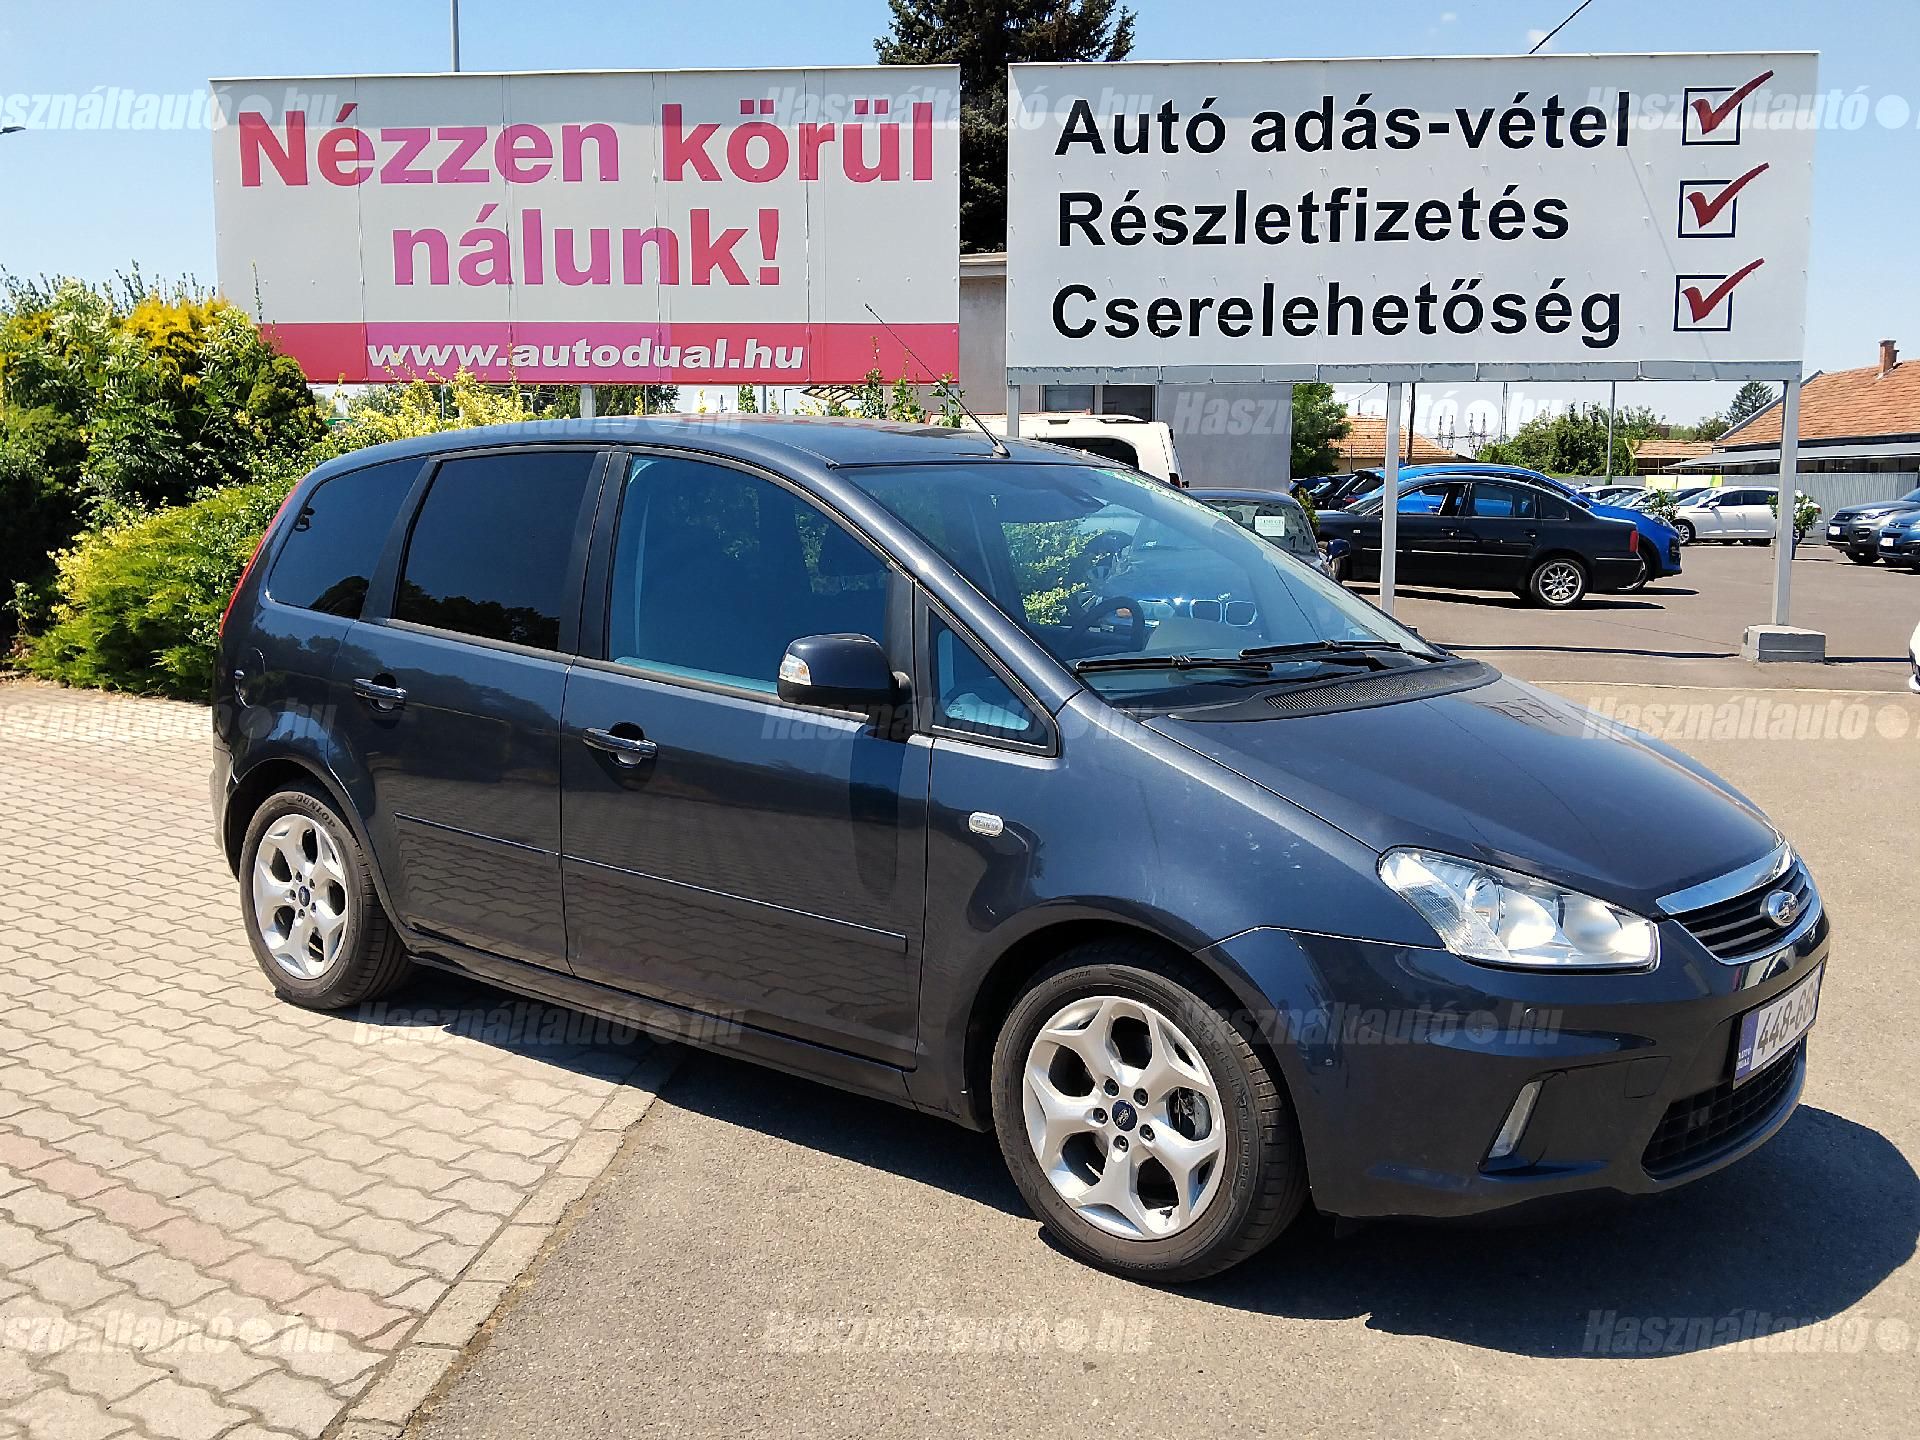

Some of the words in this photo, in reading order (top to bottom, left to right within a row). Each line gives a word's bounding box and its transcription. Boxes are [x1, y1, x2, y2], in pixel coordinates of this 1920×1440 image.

[238, 103, 620, 188] Nézzen
[662, 99, 934, 184] körül
[1054, 96, 1226, 156] Autó
[1251, 91, 1630, 153] adás-vétel
[392, 203, 780, 287] nálunk!
[1059, 184, 1569, 247] Részletfizetés
[1052, 277, 1620, 349] Cserelehetőség
[367, 337, 804, 370] www.autodual.hu
[296, 794, 336, 828] DUNLOP
